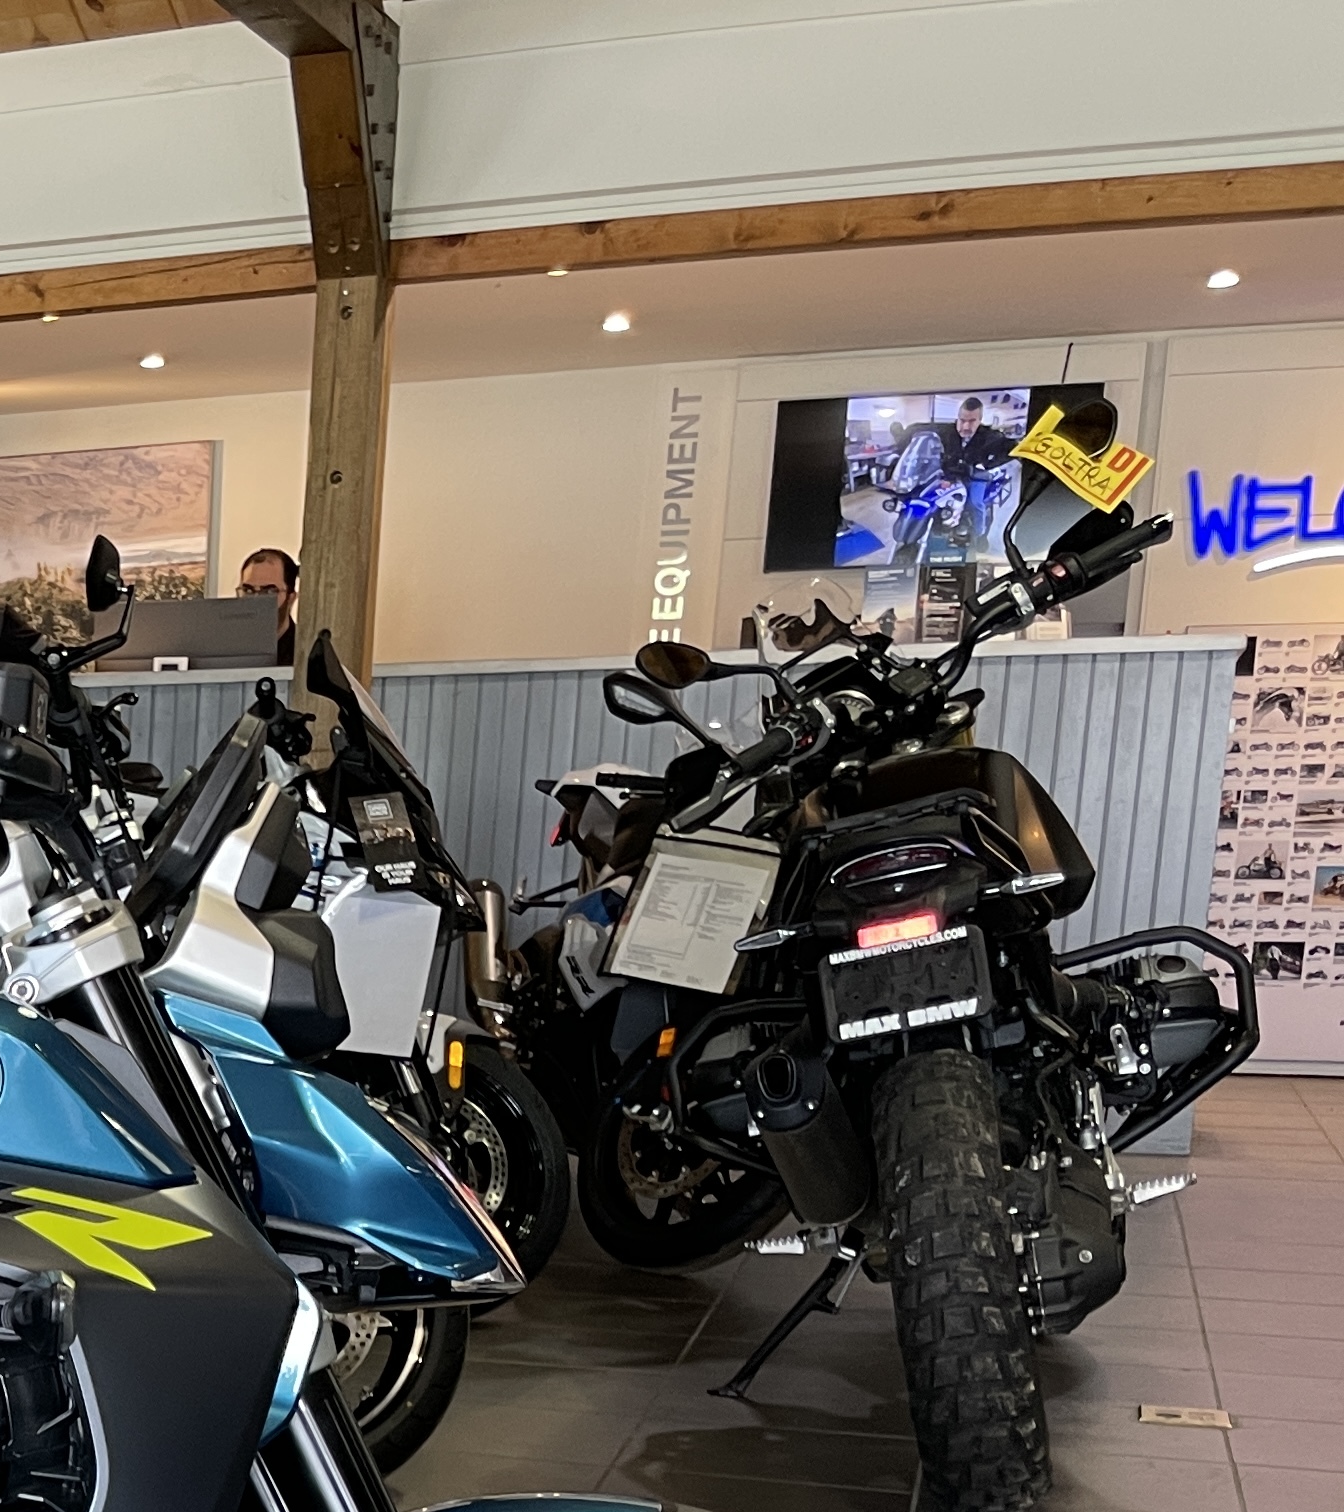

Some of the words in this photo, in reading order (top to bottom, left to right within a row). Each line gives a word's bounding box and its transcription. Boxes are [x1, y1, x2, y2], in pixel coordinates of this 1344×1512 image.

[652, 387, 703, 621] EQUIPMENT
[828, 926, 968, 965] MAXBMWMOTORCYCLES.COM
[839, 1013, 902, 1041] MAX
[907, 997, 979, 1027] BMW
